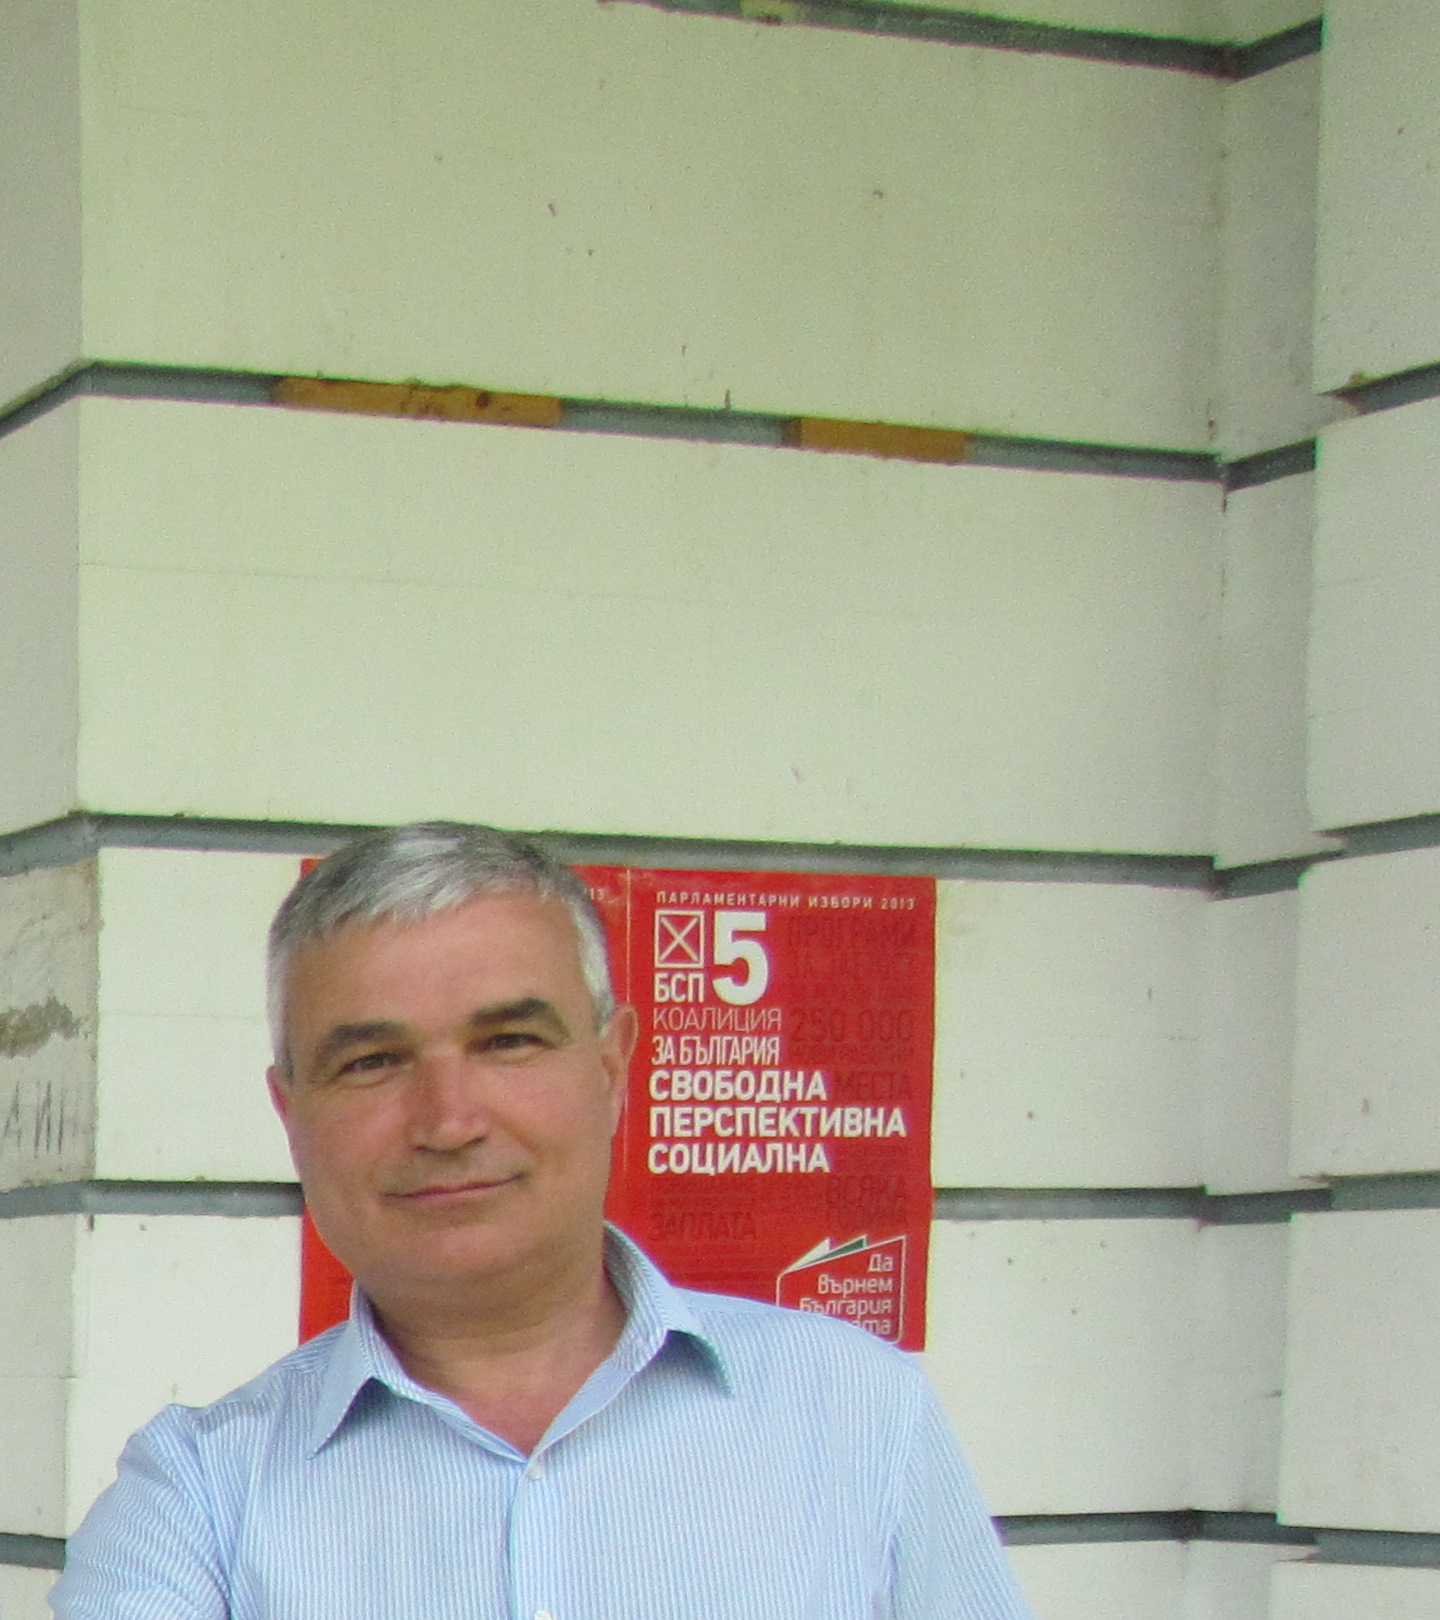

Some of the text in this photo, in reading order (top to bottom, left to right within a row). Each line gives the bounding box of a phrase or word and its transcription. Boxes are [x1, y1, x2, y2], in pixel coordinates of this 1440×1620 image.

[656, 890, 916, 910] ПАРЛАМЕНТАРНИ ИЗБОРИ 2013
[712, 910, 770, 1006] 5
[653, 971, 706, 1003] БСП
[652, 1006, 782, 1034] КОАЛИЦИЯ
[651, 1035, 676, 1066] ЗА
[680, 1035, 781, 1066] БЪЛГАРИЯ
[648, 1068, 828, 1104] СВОБОДНА
[649, 1105, 908, 1138] ПЕРСПЕКТИВНА
[647, 1141, 831, 1177] СОЦИАЛНА
[867, 1252, 894, 1273] Да
[817, 1273, 894, 1299] върнем
[799, 1297, 893, 1321] България
